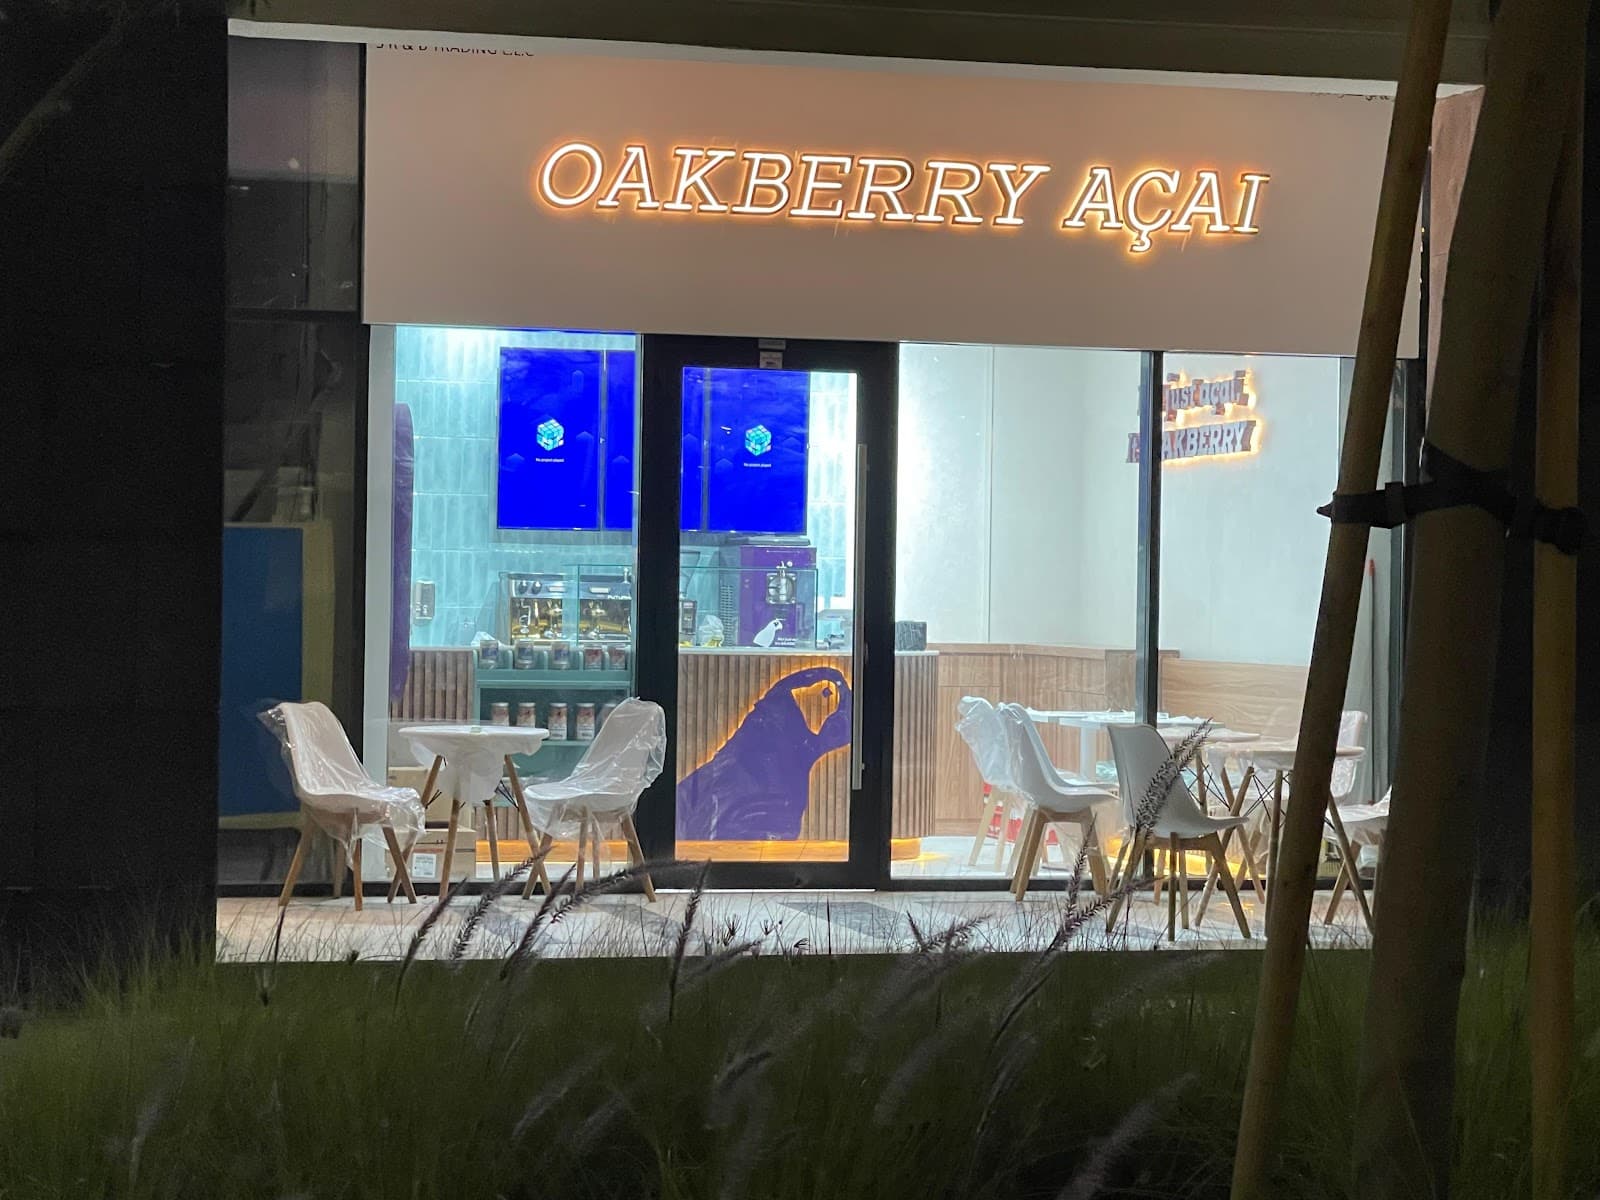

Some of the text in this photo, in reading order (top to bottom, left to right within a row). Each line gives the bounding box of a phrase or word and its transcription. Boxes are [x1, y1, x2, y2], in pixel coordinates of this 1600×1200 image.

[539, 142, 1271, 254] OAKBERRY AÇAI
[1160, 420, 1252, 462] AKBERRY
